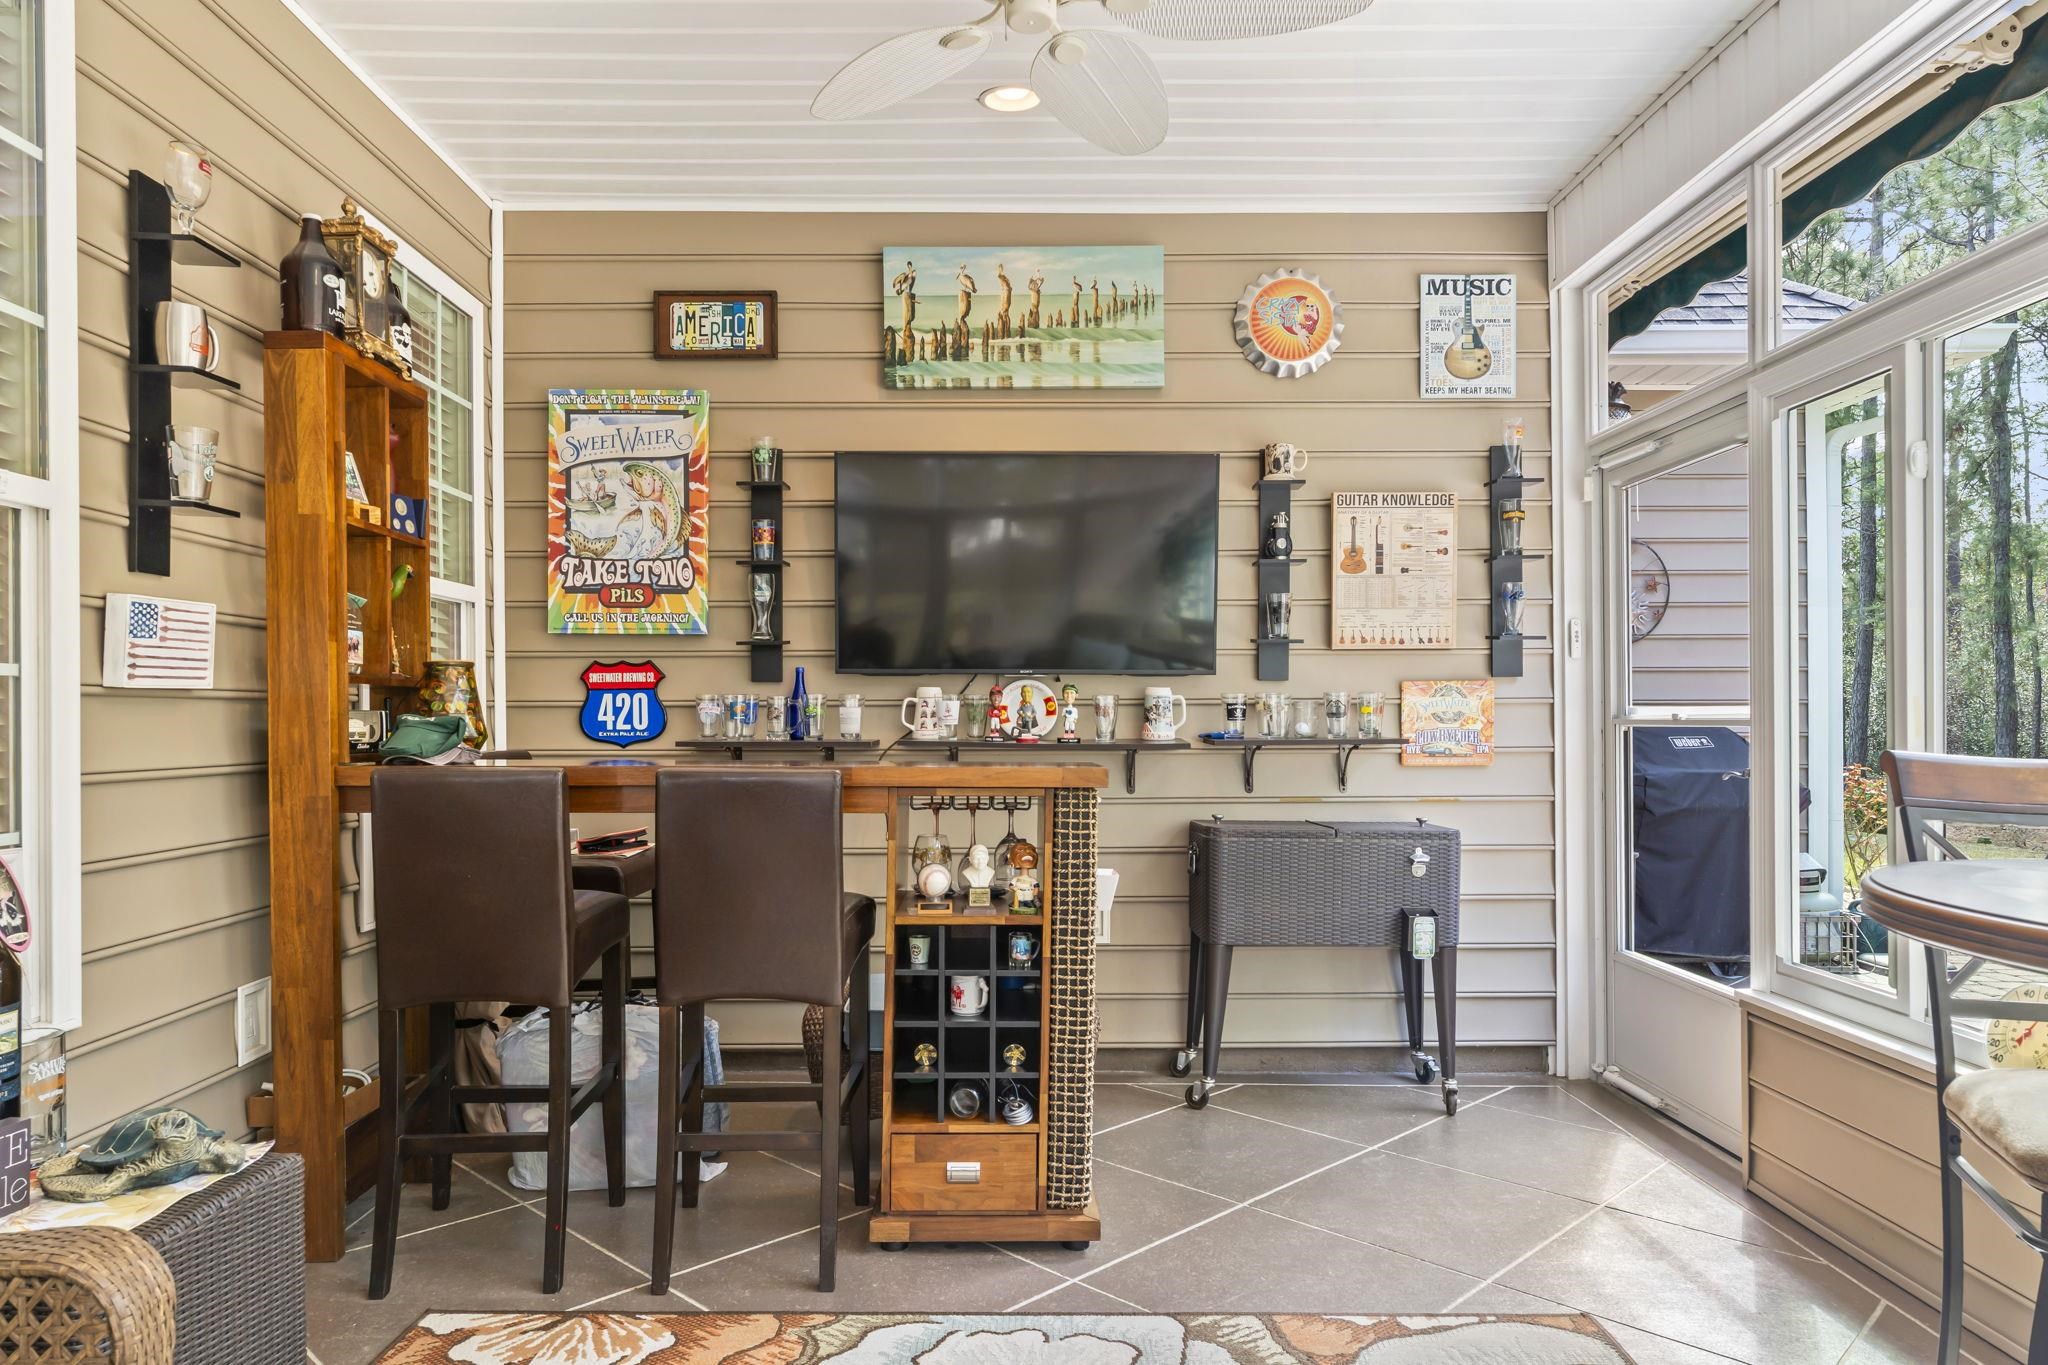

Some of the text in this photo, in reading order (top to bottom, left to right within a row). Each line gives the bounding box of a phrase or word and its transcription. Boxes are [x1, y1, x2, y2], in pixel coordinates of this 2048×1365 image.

[1425, 278, 1512, 296] MUSIC
[1255, 296, 1305, 314] CRAZY
[675, 309, 756, 345] AMERICA
[1425, 386, 1512, 395] KEEPS MY HEART BEATING
[579, 393, 609, 405] FLOAT
[611, 393, 630, 405] THE
[1336, 493, 1455, 506] GUITAR KNOWLEDGE
[560, 557, 694, 588] TAKE TWO
[564, 612, 589, 623] CALL
[590, 612, 604, 623] US
[619, 612, 639, 623] THE
[589, 672, 656, 683] SWEETWATER BREWING CO.
[597, 692, 649, 731] 420
[1406, 744, 1421, 754] RYE
[1475, 744, 1490, 754] IPA
[2023, 989, 2035, 998] 40
[1993, 1020, 2000, 1028] 0
[1987, 1038, 2000, 1048] -20
[1990, 1053, 2004, 1063] -40
[0, 1128, 28, 1169] E
